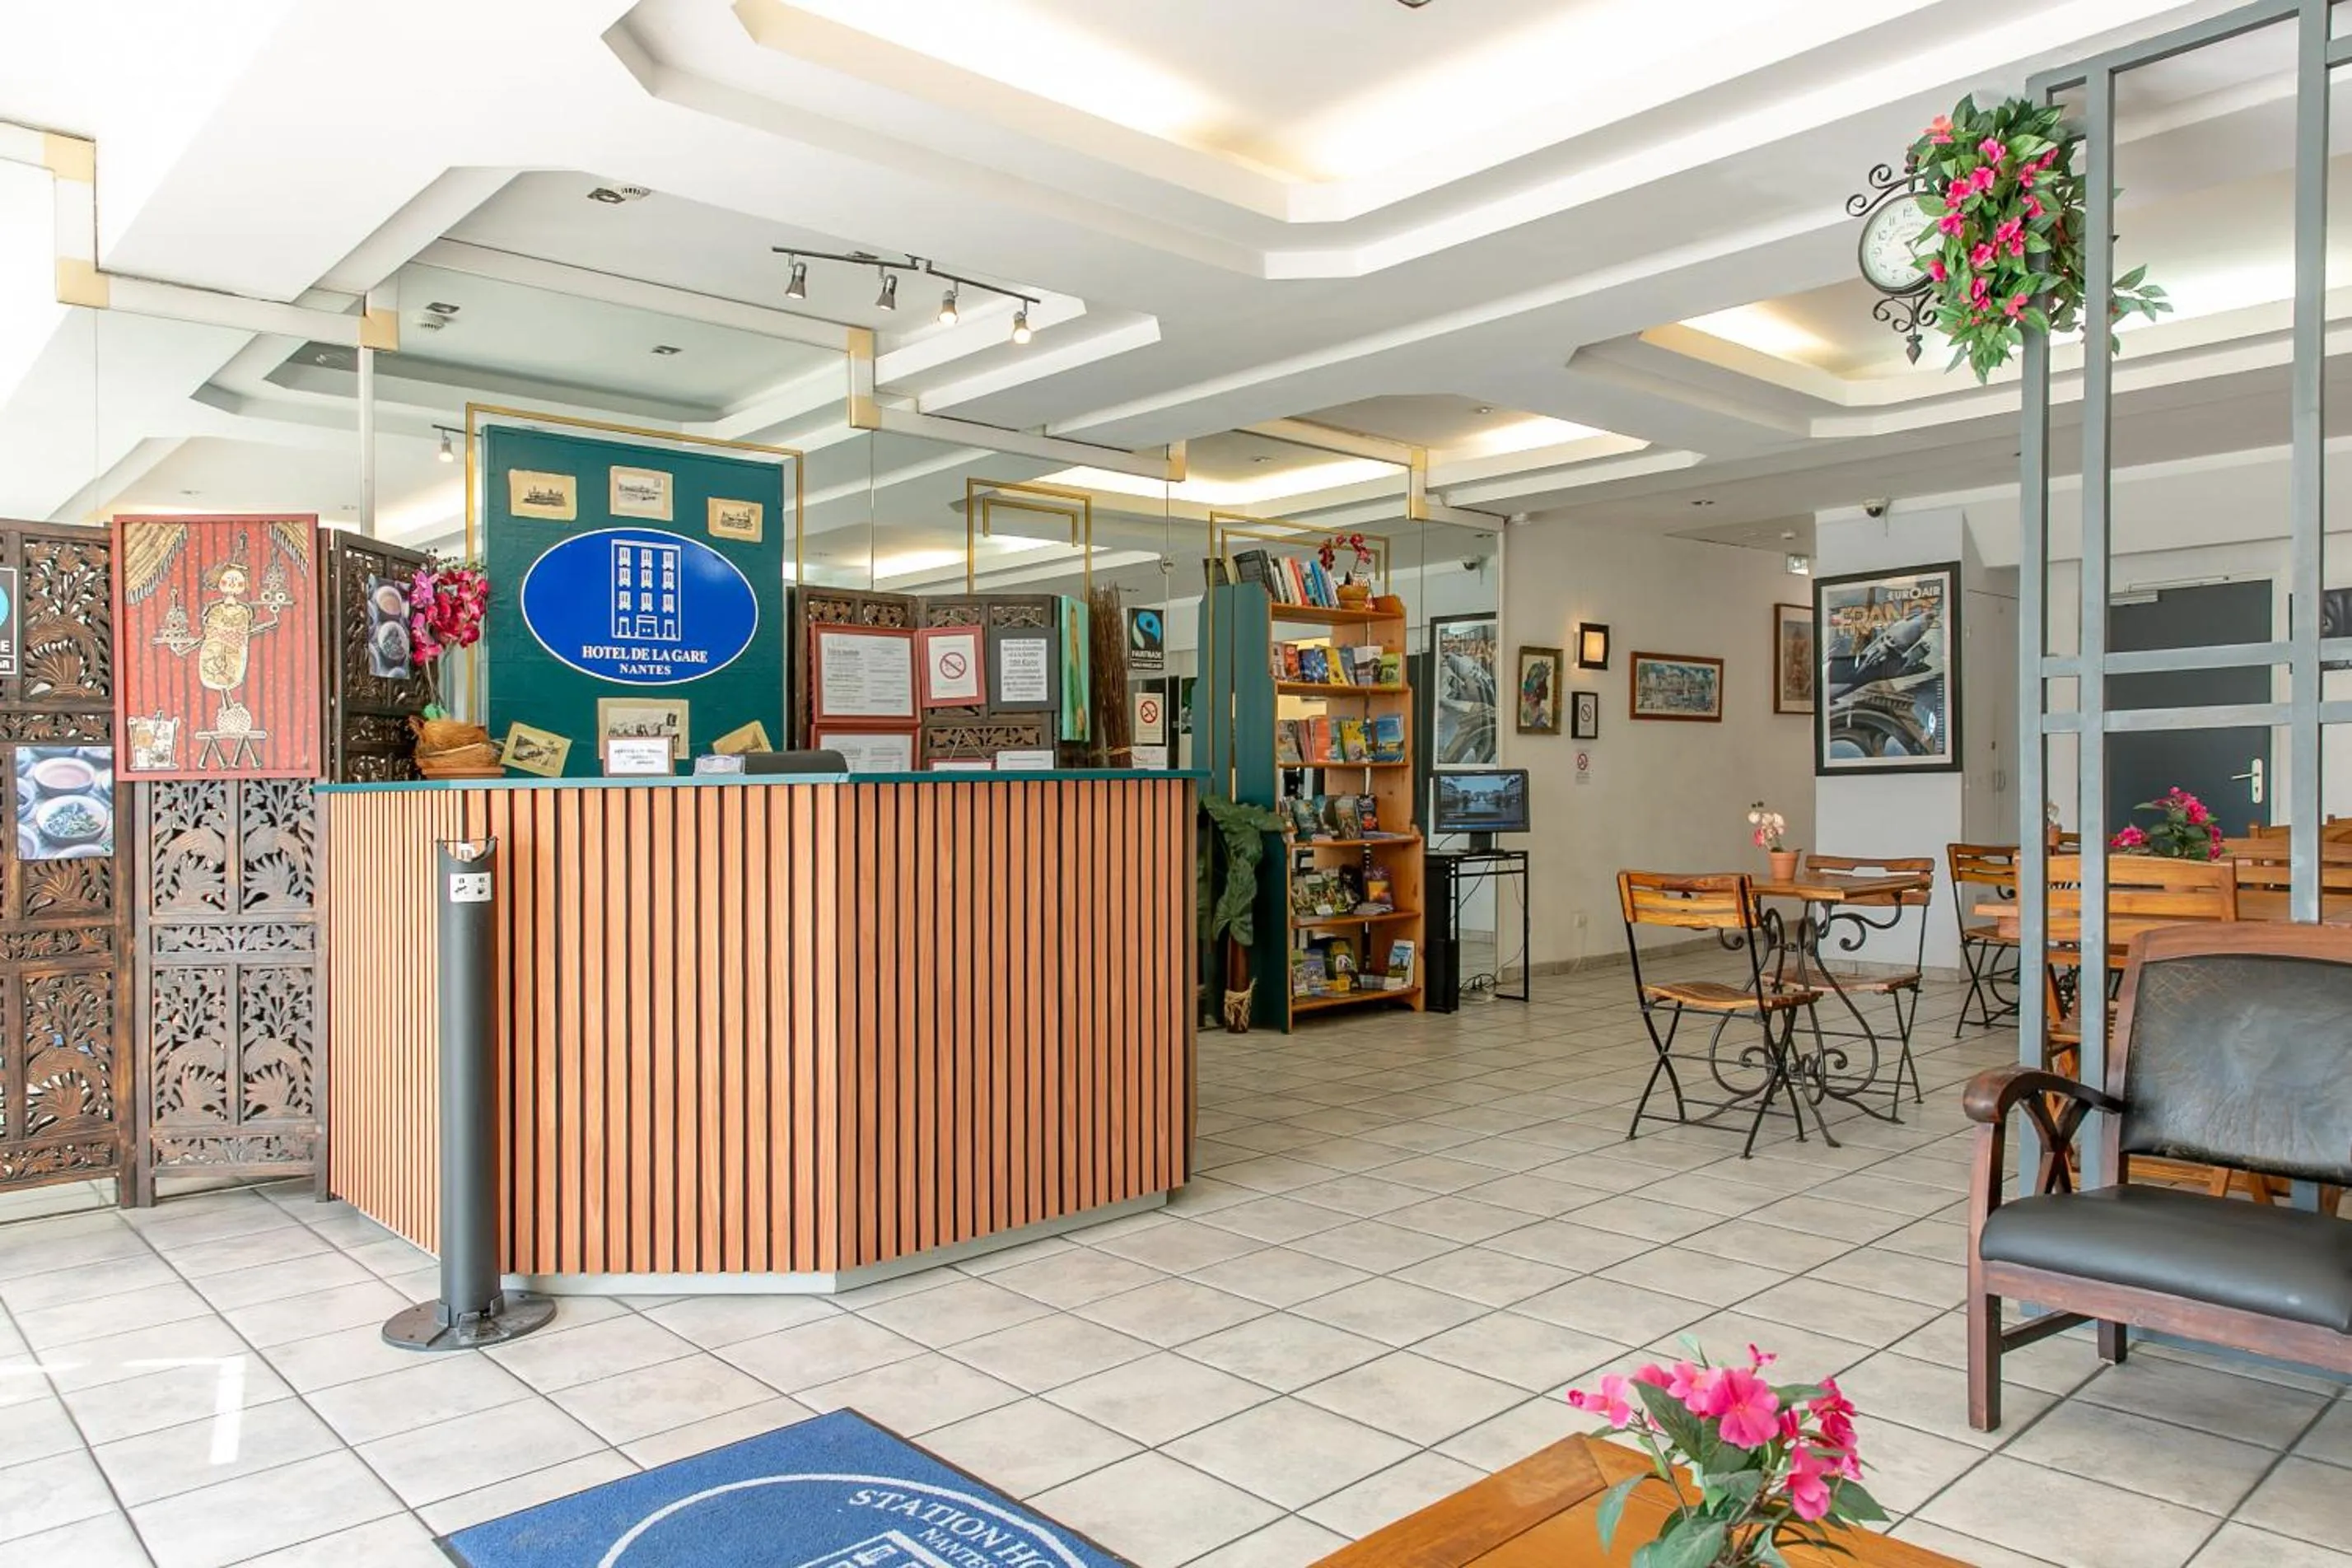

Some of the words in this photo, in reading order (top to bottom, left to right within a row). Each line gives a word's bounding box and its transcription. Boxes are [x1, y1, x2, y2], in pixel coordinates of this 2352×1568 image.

[581, 645, 629, 660] HOTEL
[631, 646, 650, 661] DE
[652, 648, 670, 662] LA
[671, 649, 708, 664] GARE
[618, 663, 672, 675] NANTES
[848, 1489, 1015, 1549] STATION
